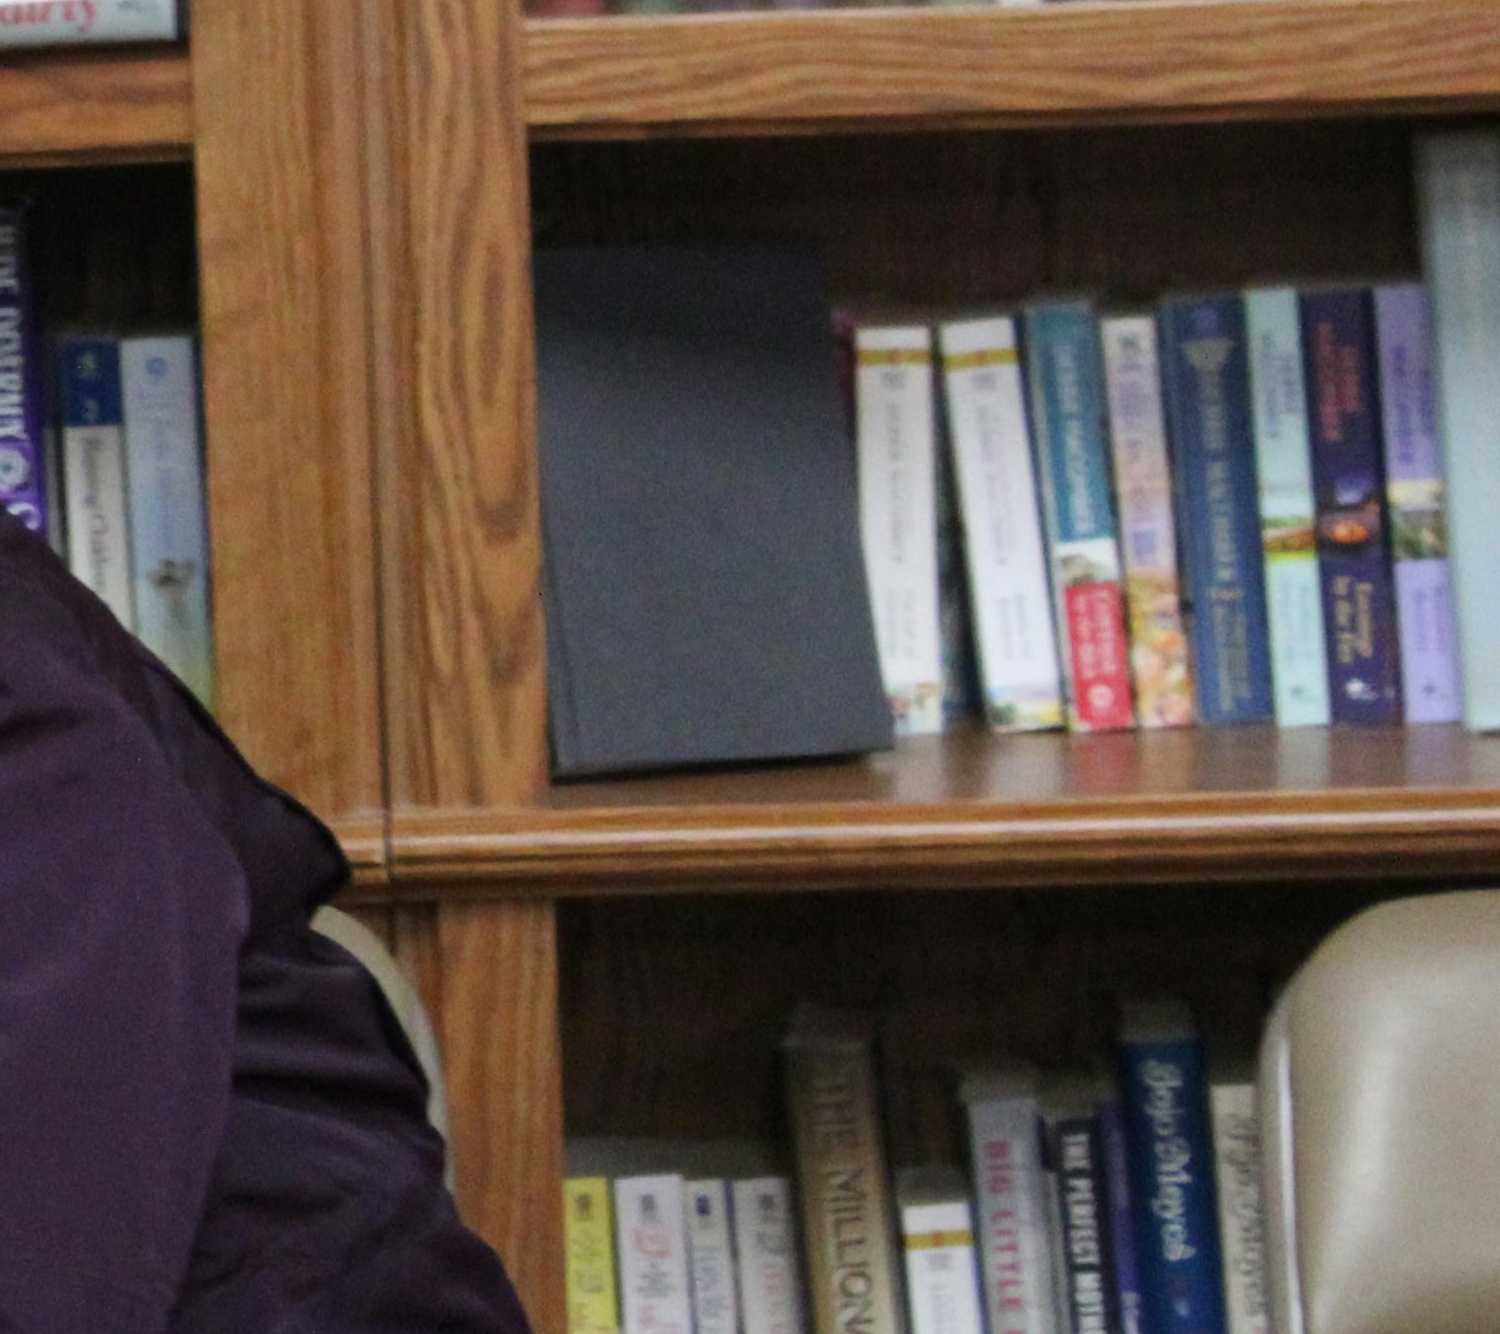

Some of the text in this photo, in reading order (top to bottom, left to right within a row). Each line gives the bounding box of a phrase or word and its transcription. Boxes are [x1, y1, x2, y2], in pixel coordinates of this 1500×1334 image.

[984, 1139, 1015, 1196] BIG
[1062, 1133, 1090, 1170] THE
[1140, 1060, 1197, 1263] Jojo Moyes
[990, 1208, 1024, 1313] LITTLE
[1065, 1178, 1099, 1264] PERFECT
